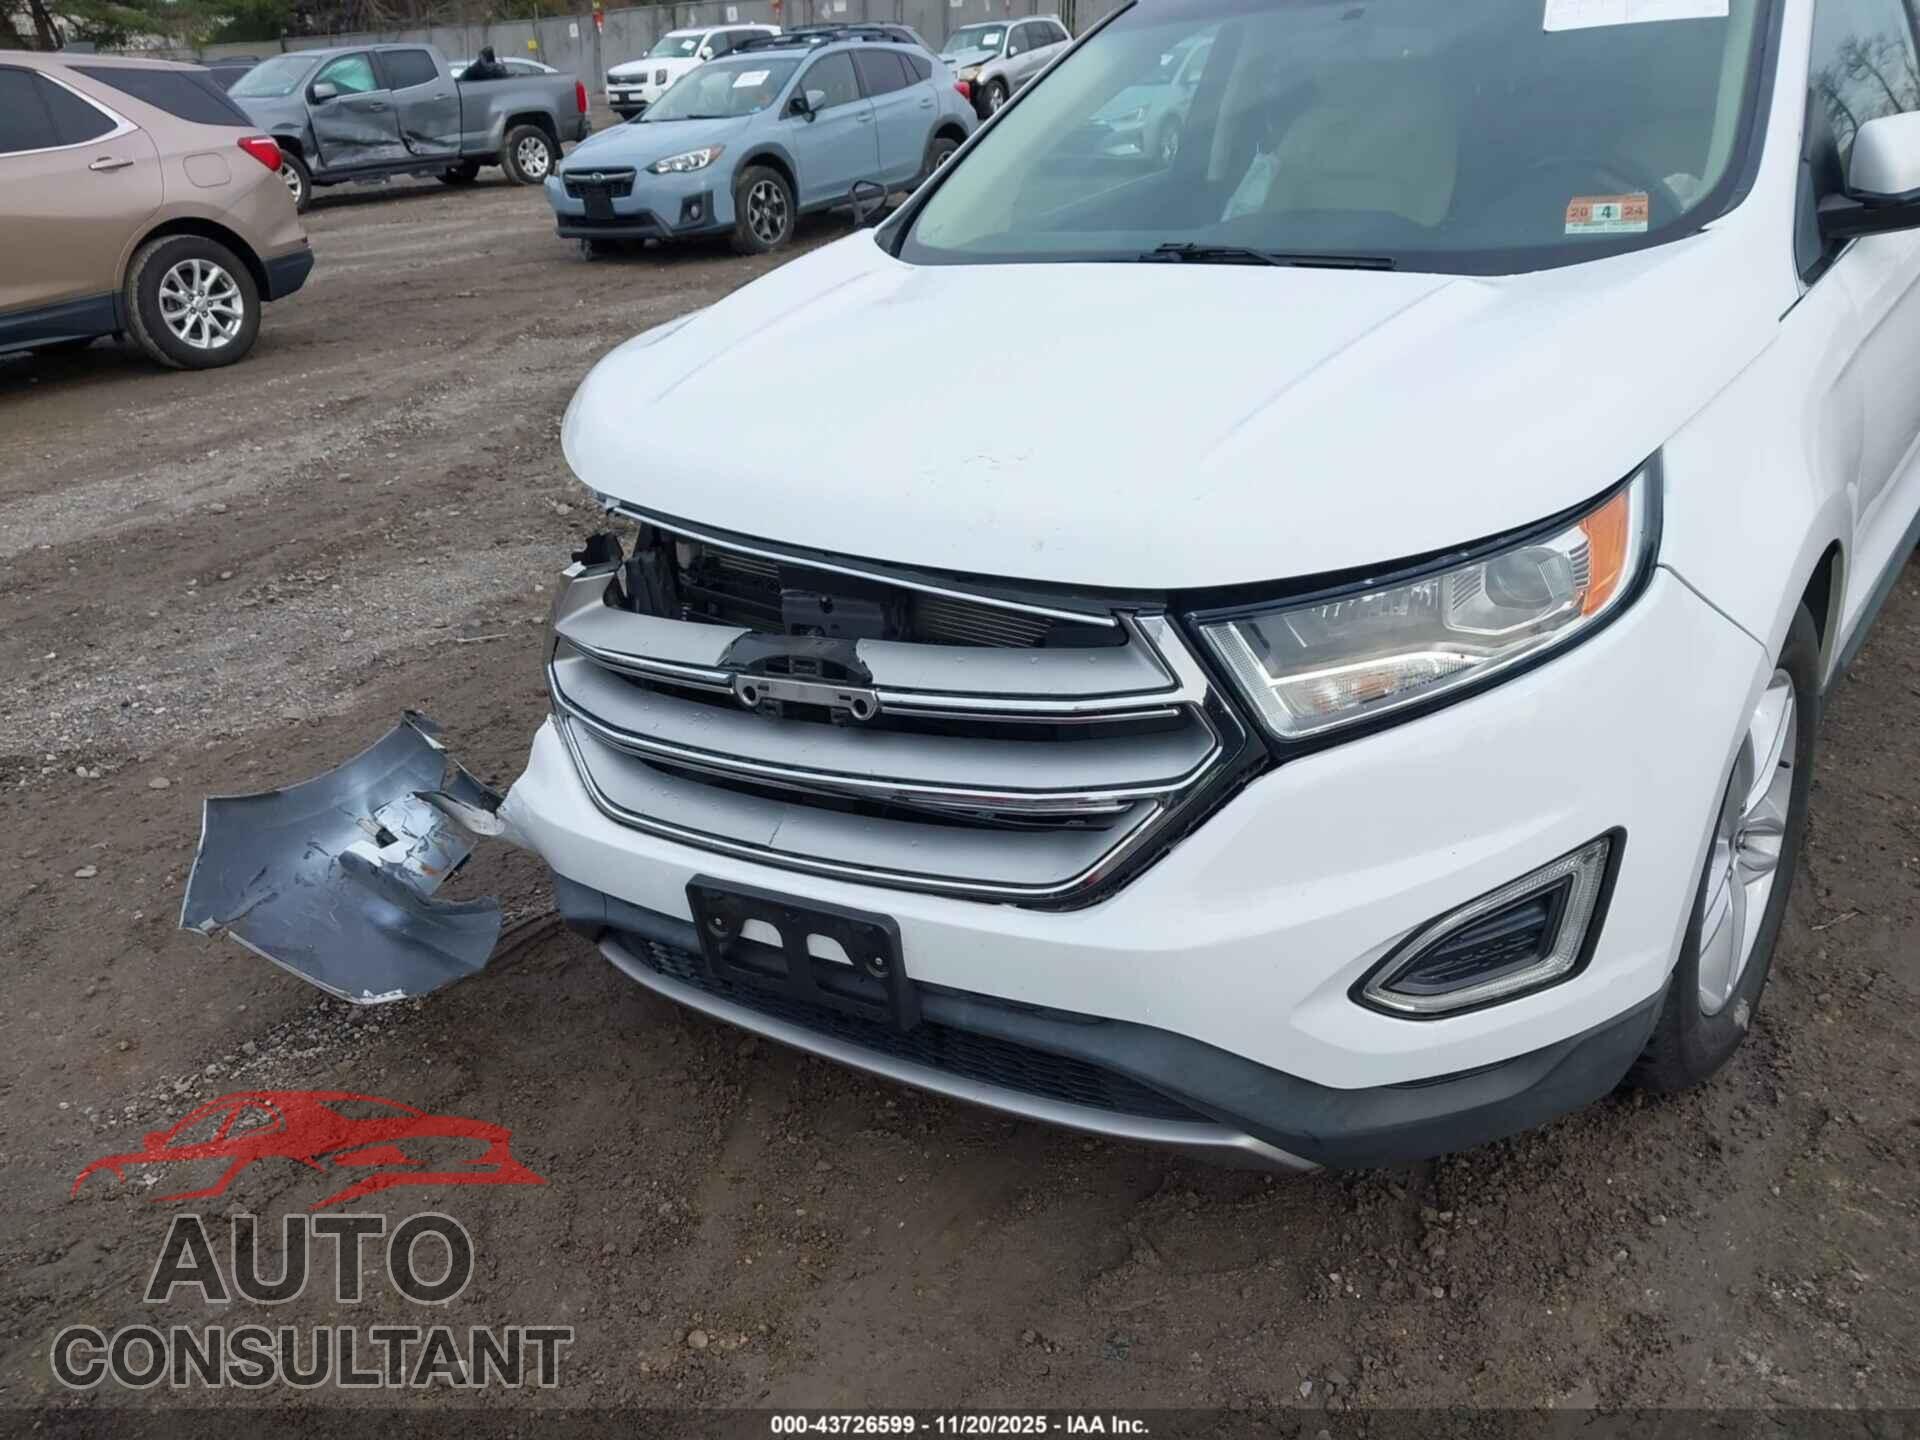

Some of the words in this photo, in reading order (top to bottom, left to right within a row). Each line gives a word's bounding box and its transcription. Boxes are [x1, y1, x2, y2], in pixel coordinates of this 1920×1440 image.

[1570, 206, 1588, 217] 20
[1602, 206, 1611, 218] 4
[1624, 206, 1643, 216] 24
